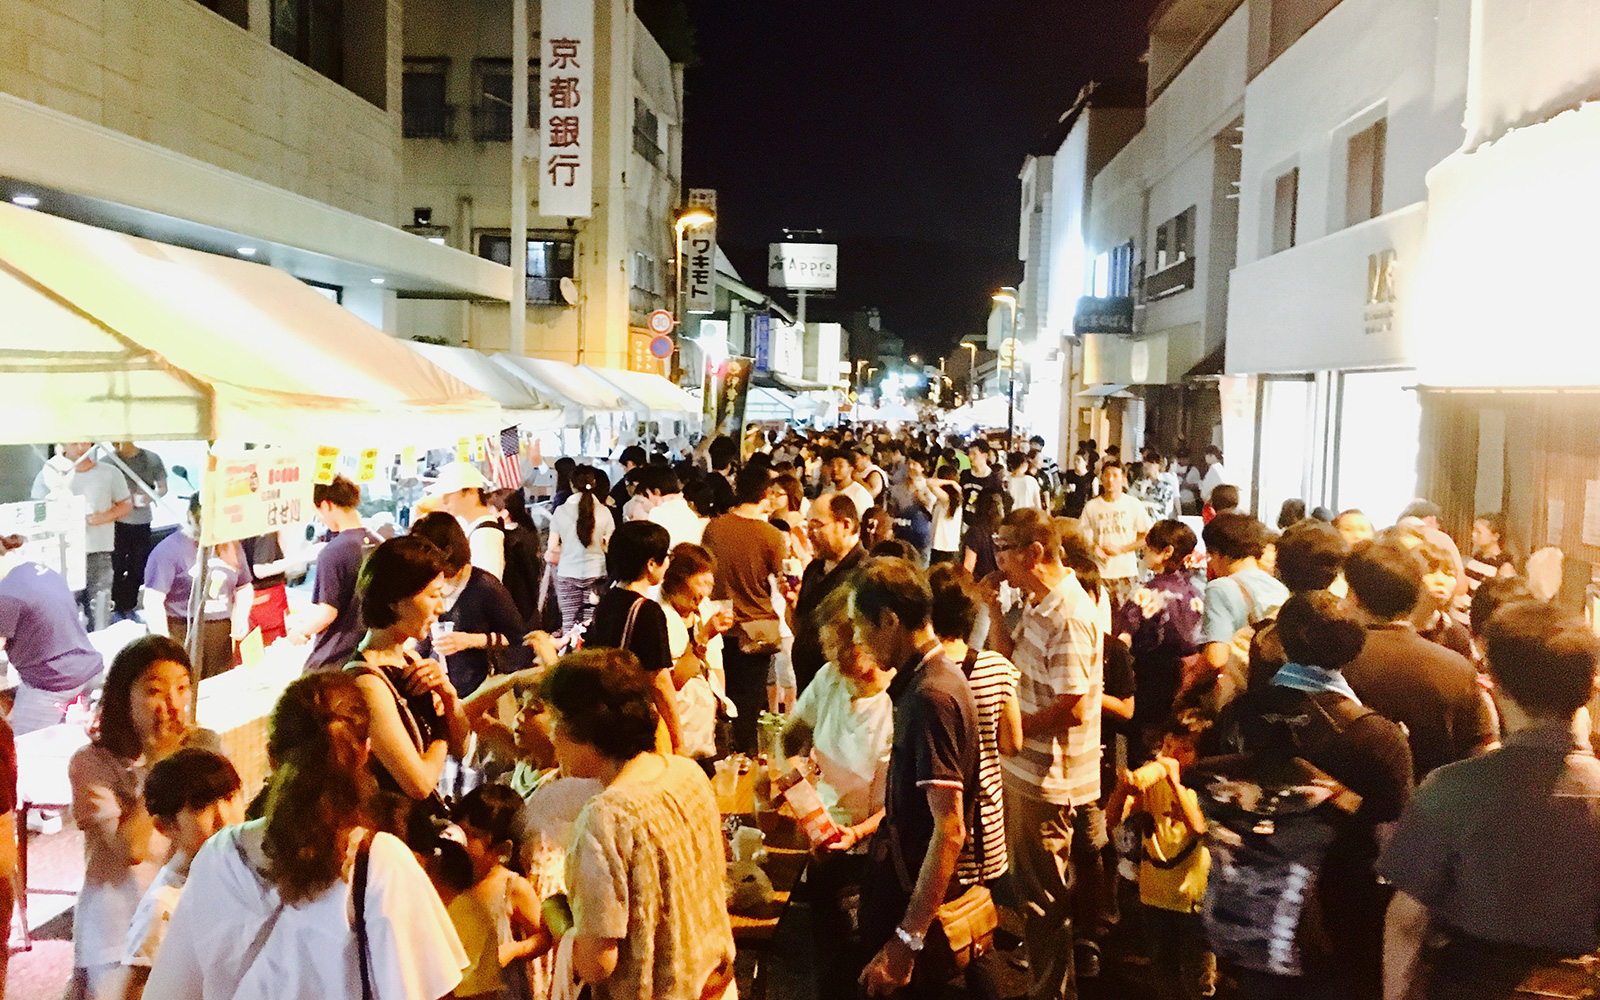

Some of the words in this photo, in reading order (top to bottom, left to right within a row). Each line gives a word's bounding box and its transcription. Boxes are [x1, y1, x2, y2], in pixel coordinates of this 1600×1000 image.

[548, 37, 581, 187] 京都銀行
[691, 239, 710, 299] ワキモト
[653, 316, 667, 328] 30
